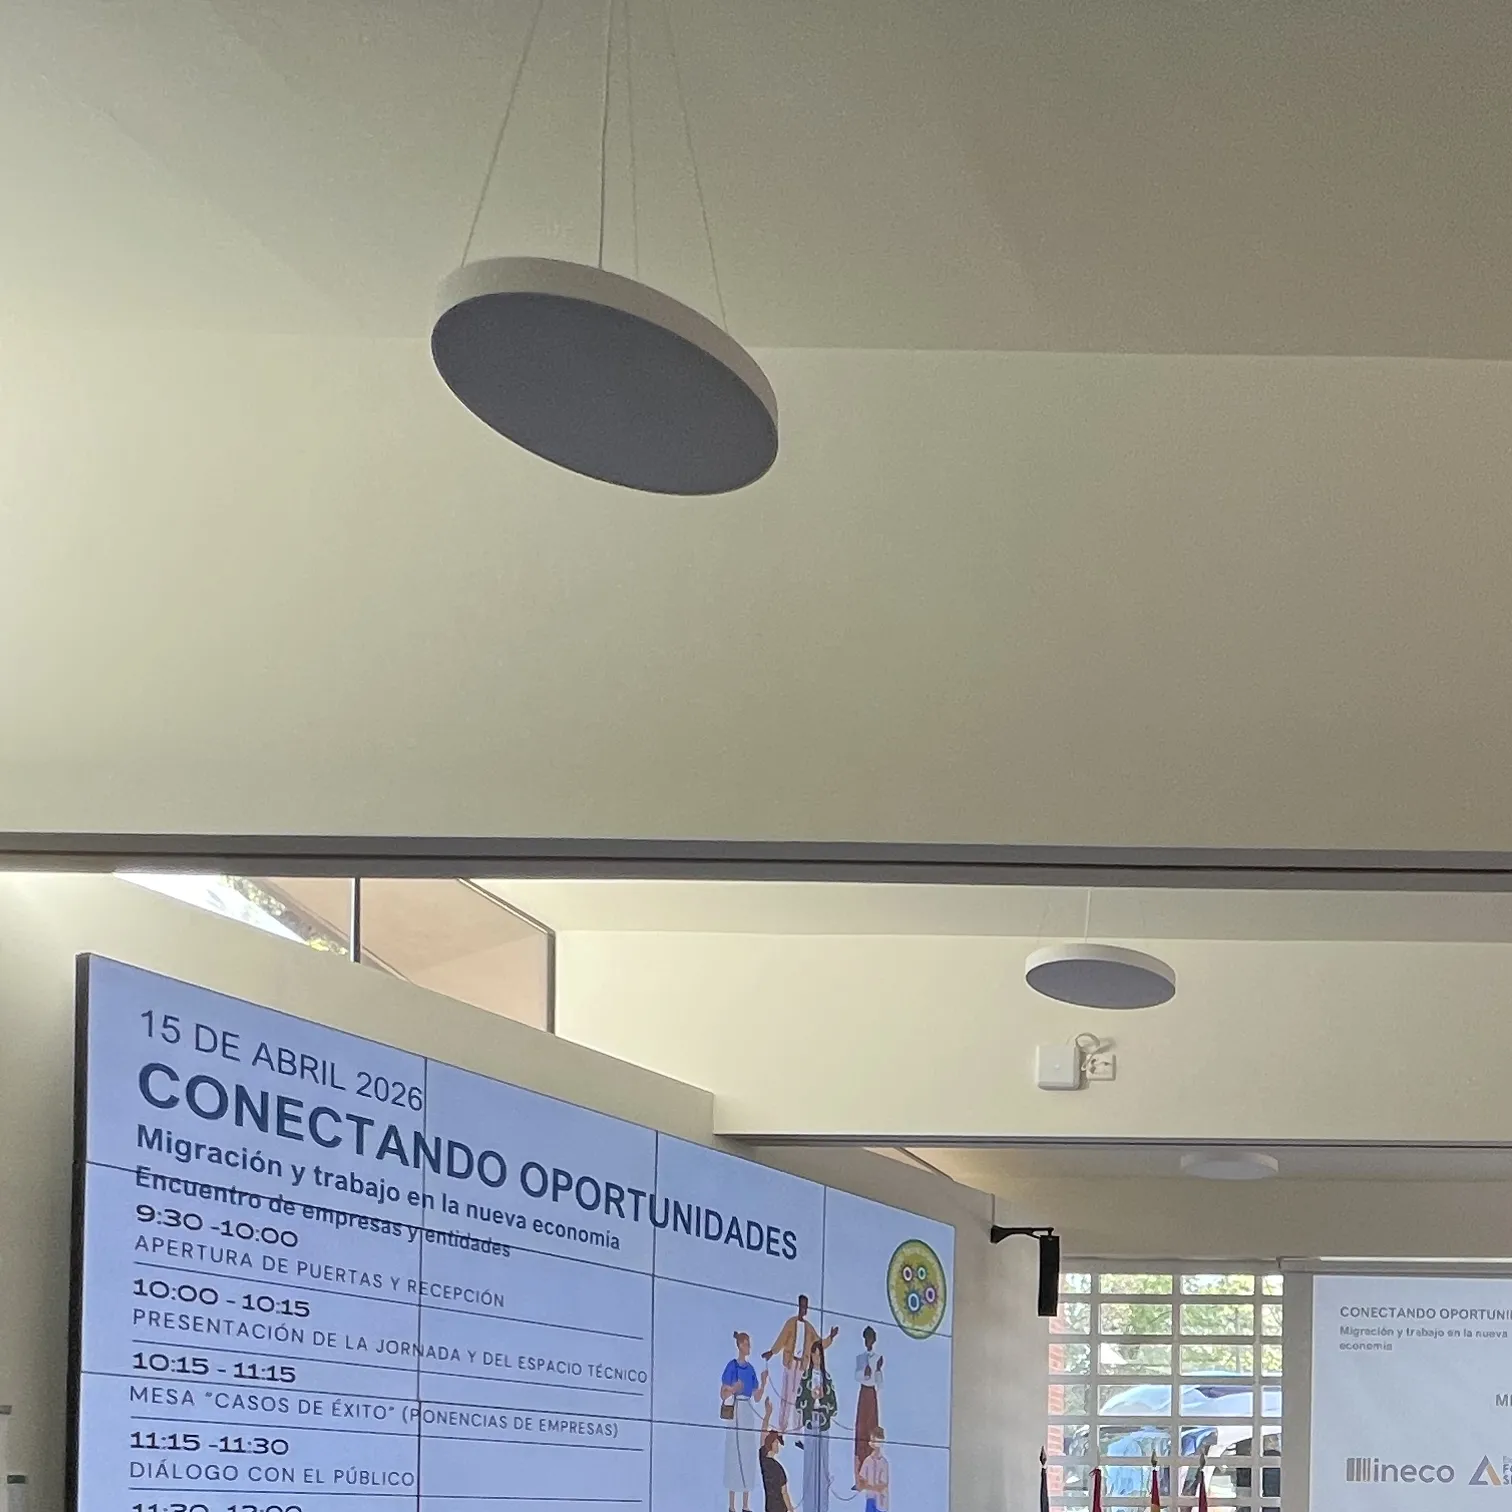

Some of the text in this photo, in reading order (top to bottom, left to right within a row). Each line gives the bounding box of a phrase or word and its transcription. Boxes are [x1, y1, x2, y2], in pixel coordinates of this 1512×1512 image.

[141, 1010, 423, 1110] 15 DE ABRIL 2026
[138, 1063, 797, 1260] CONECTANDO OPORTUNIDADES
[137, 1124, 620, 1250] Migración y trabajo en la nueva economía
[136, 1167, 510, 1258] Encuentro de empresas y entidades
[137, 1204, 202, 1232] 9:30
[135, 1234, 504, 1307] APERTURA DE PUERTAS Y RECEPCIÓN
[134, 1278, 218, 1306] 10:00
[243, 1295, 310, 1317] 10:15
[1340, 1306, 1436, 1320] CONECTANDO
[134, 1309, 647, 1384] PRESENTACIÓN DE LA JORNADA Y DEL ESPACIO TÉCNICO
[1339, 1326, 1508, 1339] Migración y trabajo en la nueva
[133, 1352, 209, 1375] 10:15
[233, 1363, 296, 1383] 11:15
[130, 1387, 195, 1407] MESA
[299, 1399, 323, 1417] DE
[402, 1406, 507, 1431] (PONENCIAS
[514, 1413, 534, 1431] DE
[539, 1414, 618, 1438] EMPRESAS)
[130, 1432, 200, 1452] 11:15
[130, 1458, 414, 1487] DIÁLOGO CON EL PÚBLICO
[1373, 1458, 1455, 1483] ineco
